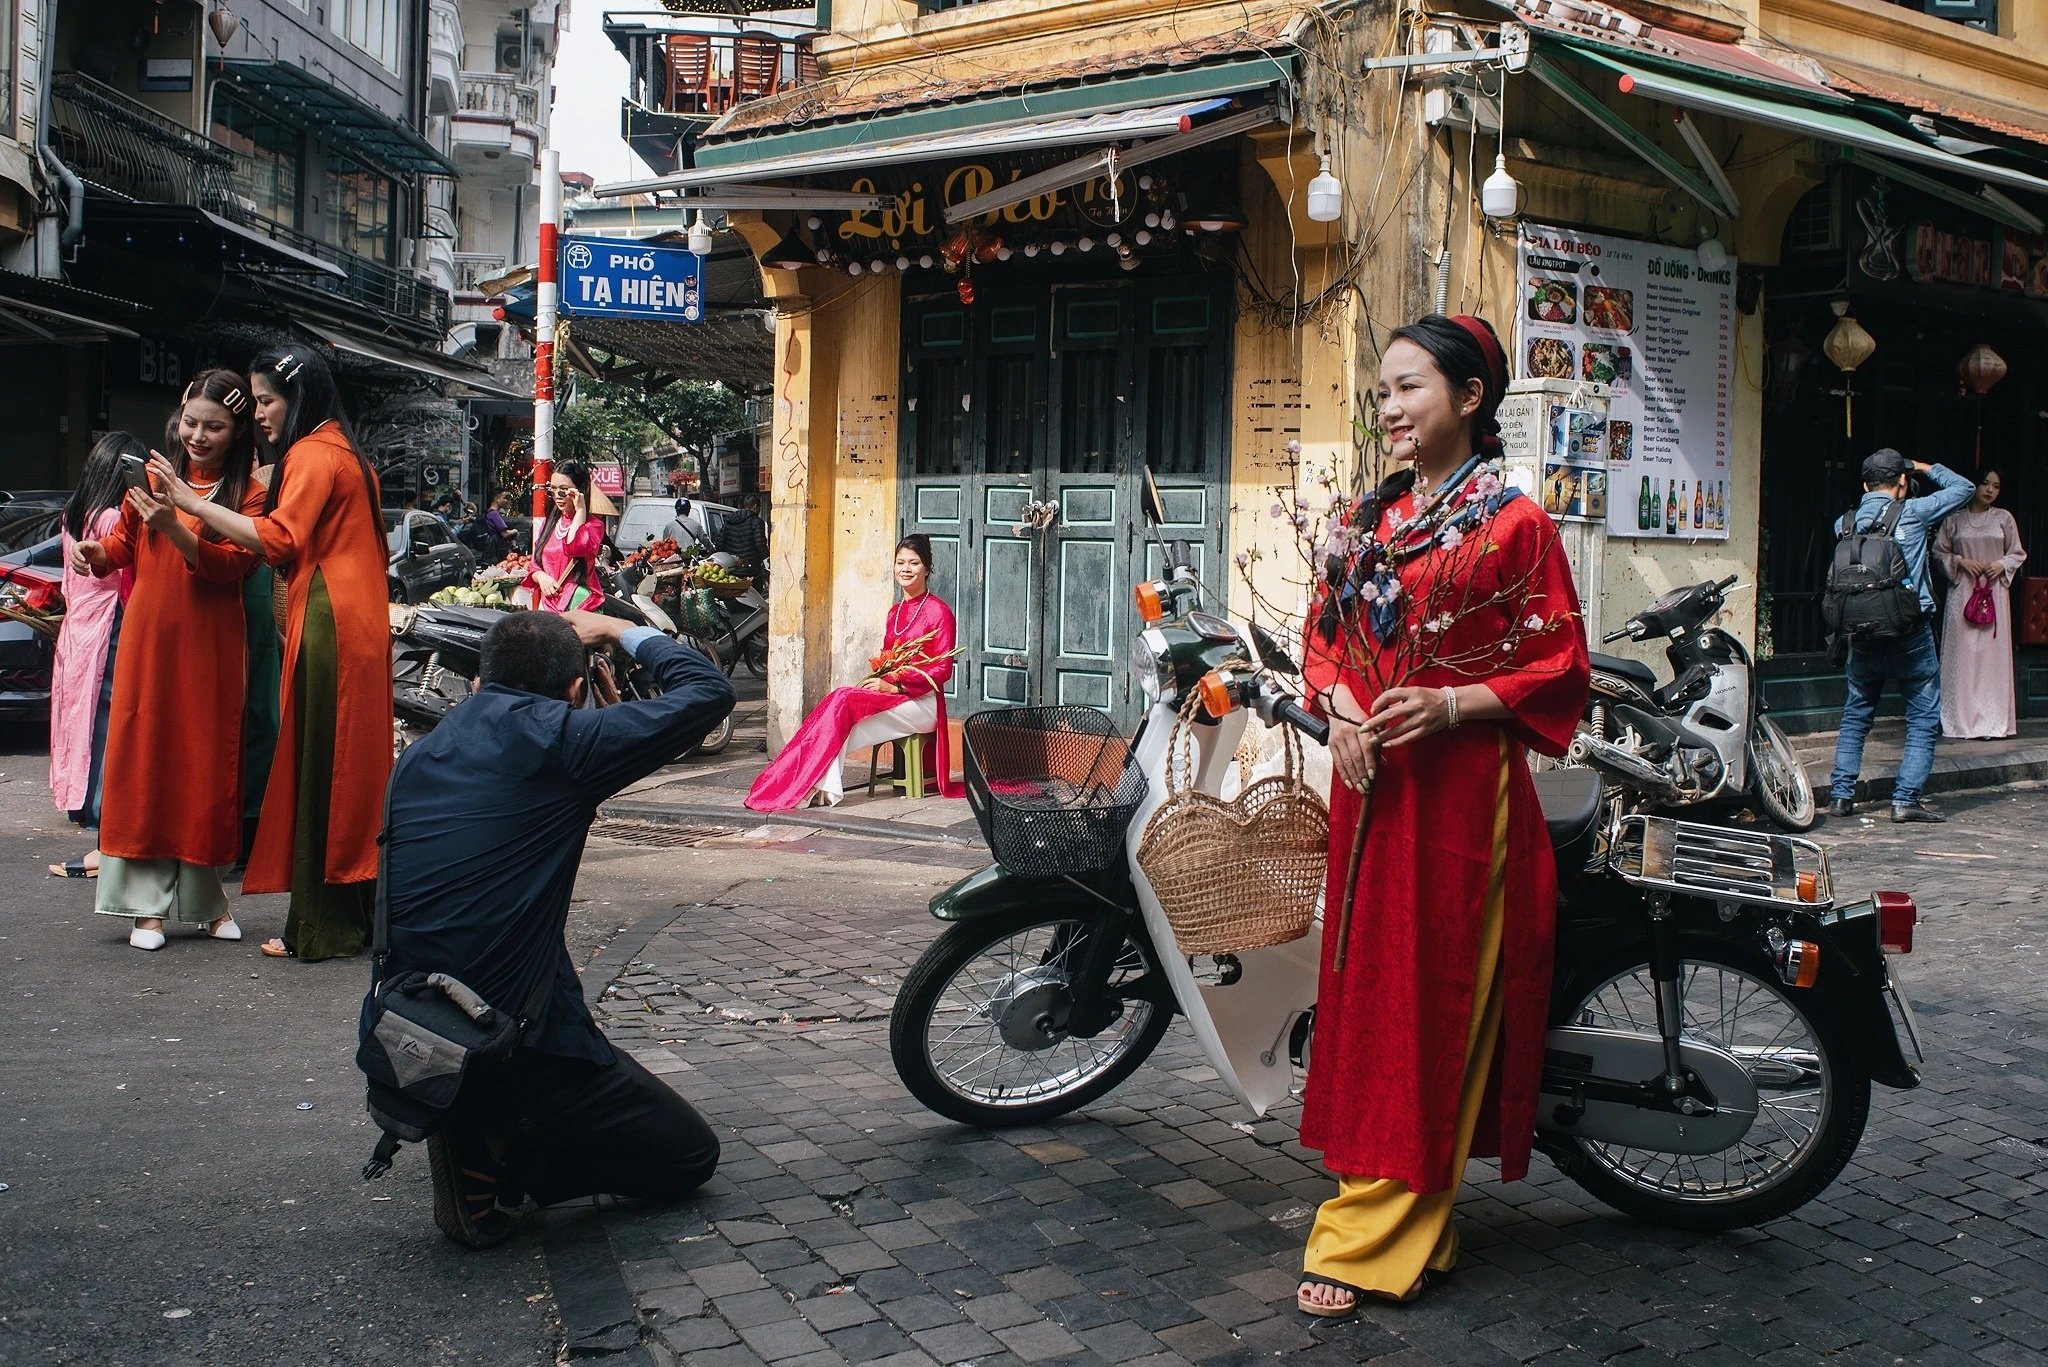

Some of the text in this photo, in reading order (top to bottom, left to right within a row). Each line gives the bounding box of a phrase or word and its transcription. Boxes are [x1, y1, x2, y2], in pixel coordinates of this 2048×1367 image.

[838, 164, 1067, 250] Lợi Béo
[1554, 239, 1574, 254] LỢI
[1577, 241, 1602, 257] BÉO
[610, 251, 655, 271] PHỐ
[1647, 256, 1731, 286] ĐỒ UỐNG DRINKS
[579, 275, 685, 311] TẠ HIỆN
[1659, 285, 1682, 293] Heineken
[1659, 295, 1682, 303] Heineken
[1659, 316, 1671, 324] Tiger
[1659, 326, 1671, 334] Tiger
[1658, 336, 1671, 344] Tiger
[140, 339, 180, 386] Bia
[1645, 365, 1671, 373] Strongbow
[1657, 406, 1682, 414] Budweiser
[1656, 436, 1679, 444] Carlsberg
[1714, 685, 1737, 695] HONDA
